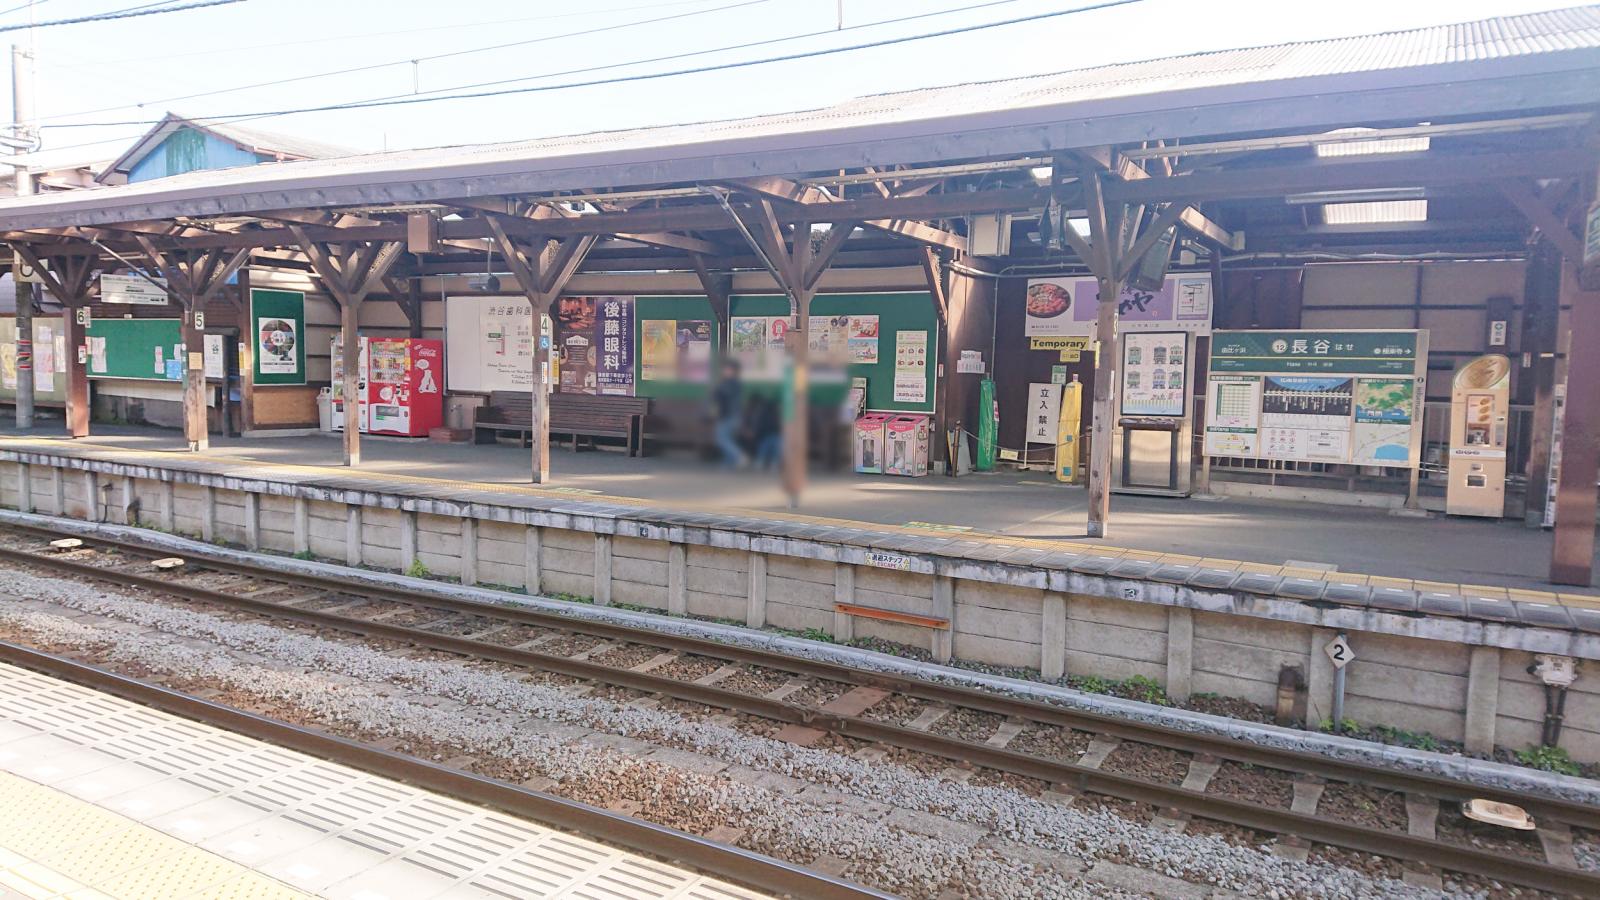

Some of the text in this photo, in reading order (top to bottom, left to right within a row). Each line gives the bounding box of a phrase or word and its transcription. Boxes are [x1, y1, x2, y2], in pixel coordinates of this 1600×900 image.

[78, 311, 84, 323] 6
[196, 315, 203, 327] 5
[542, 317, 548, 333] 4
[604, 302, 620, 370] 後藤眼科
[1032, 339, 1087, 349] Temporary
[1291, 339, 1354, 354] 長谷 はせ
[1037, 388, 1050, 437] 立入禁止
[877, 561, 897, 569] ESCAPE
[1333, 644, 1345, 661] 2
